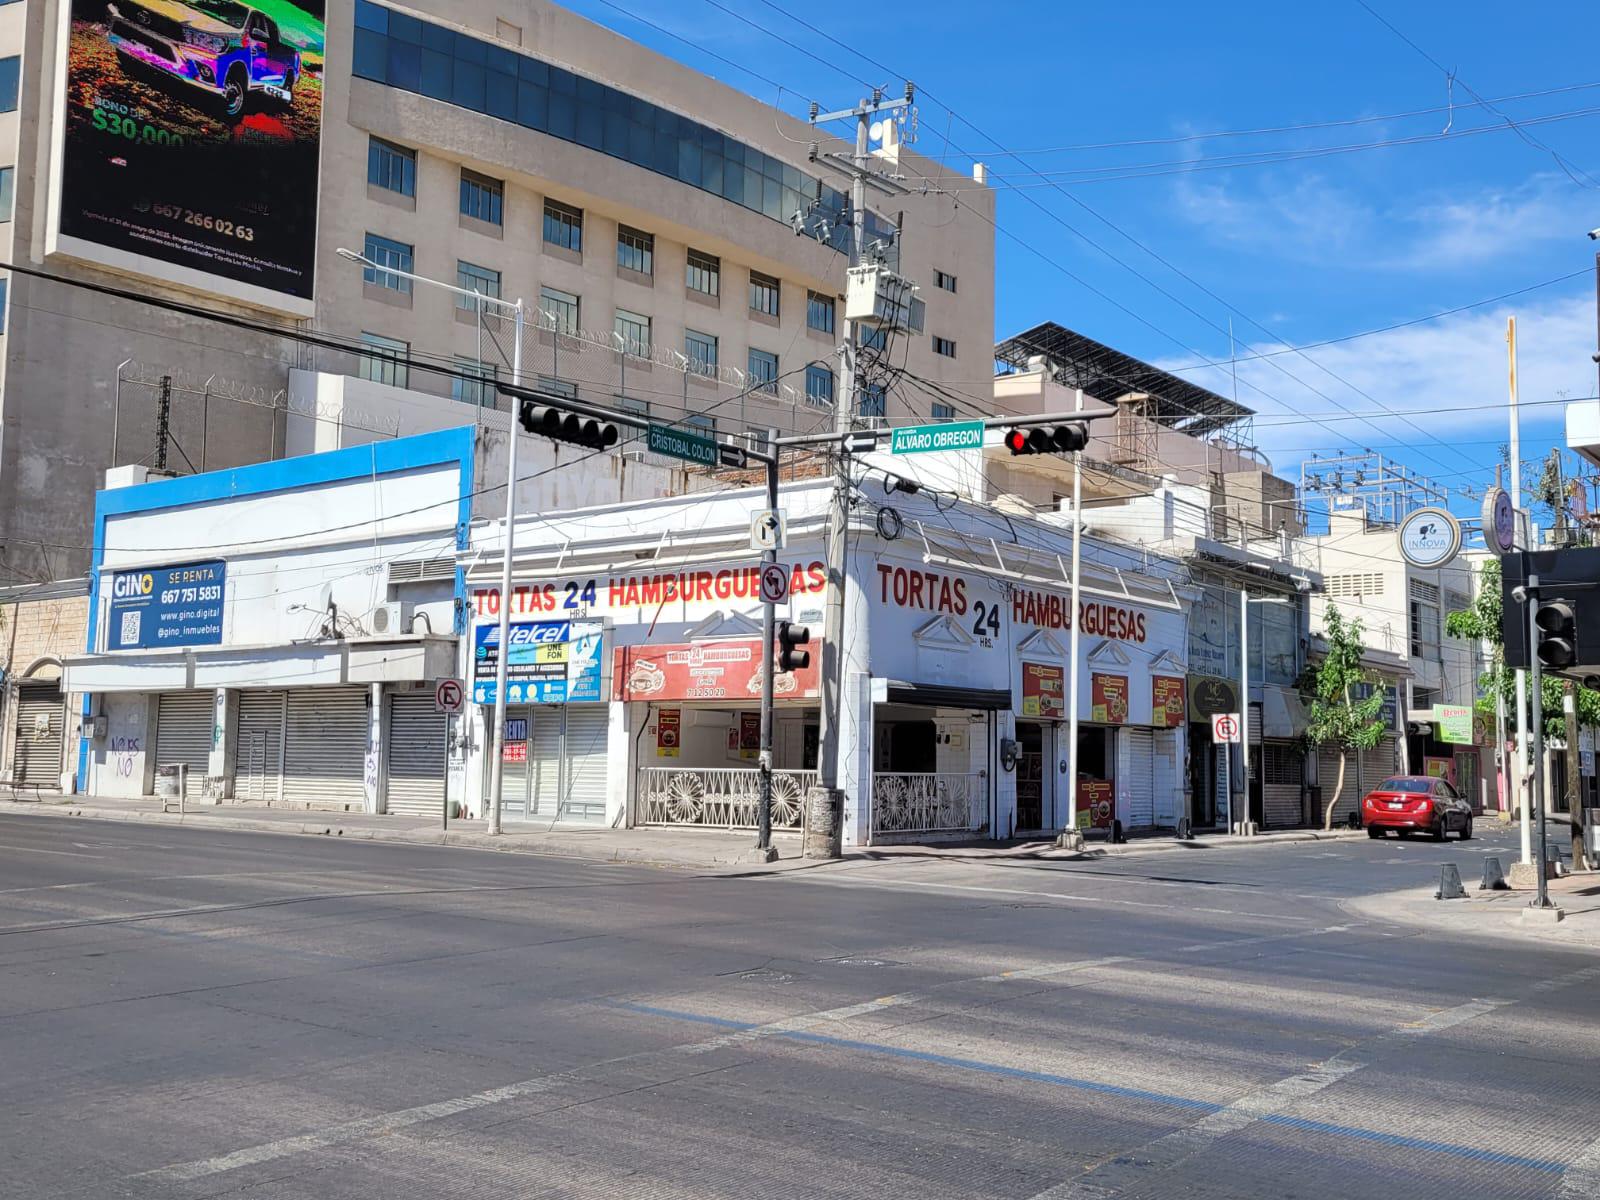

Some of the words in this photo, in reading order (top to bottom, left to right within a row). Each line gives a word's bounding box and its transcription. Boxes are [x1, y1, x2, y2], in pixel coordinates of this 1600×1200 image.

[185, 210, 212, 229] 266
[216, 220, 233, 236] 02
[236, 226, 254, 241] 63
[651, 434, 691, 456] CRISTOBAL
[692, 444, 715, 462] COLON
[894, 434, 931, 450] ALVARO
[934, 430, 981, 447] OBREGON
[1409, 540, 1446, 548] INNOVA
[115, 574, 153, 596] GINO
[169, 573, 179, 584] SE
[183, 569, 214, 582] RENTA
[564, 579, 596, 609] 24
[609, 561, 824, 607] HAMBURGUEAS
[162, 590, 179, 604] 667
[182, 588, 196, 602] 751
[199, 586, 220, 600] 5831
[877, 564, 967, 616] TORTAS
[974, 600, 999, 638] 24
[161, 608, 219, 621] www.gino.digital
[508, 624, 568, 644] telcel
